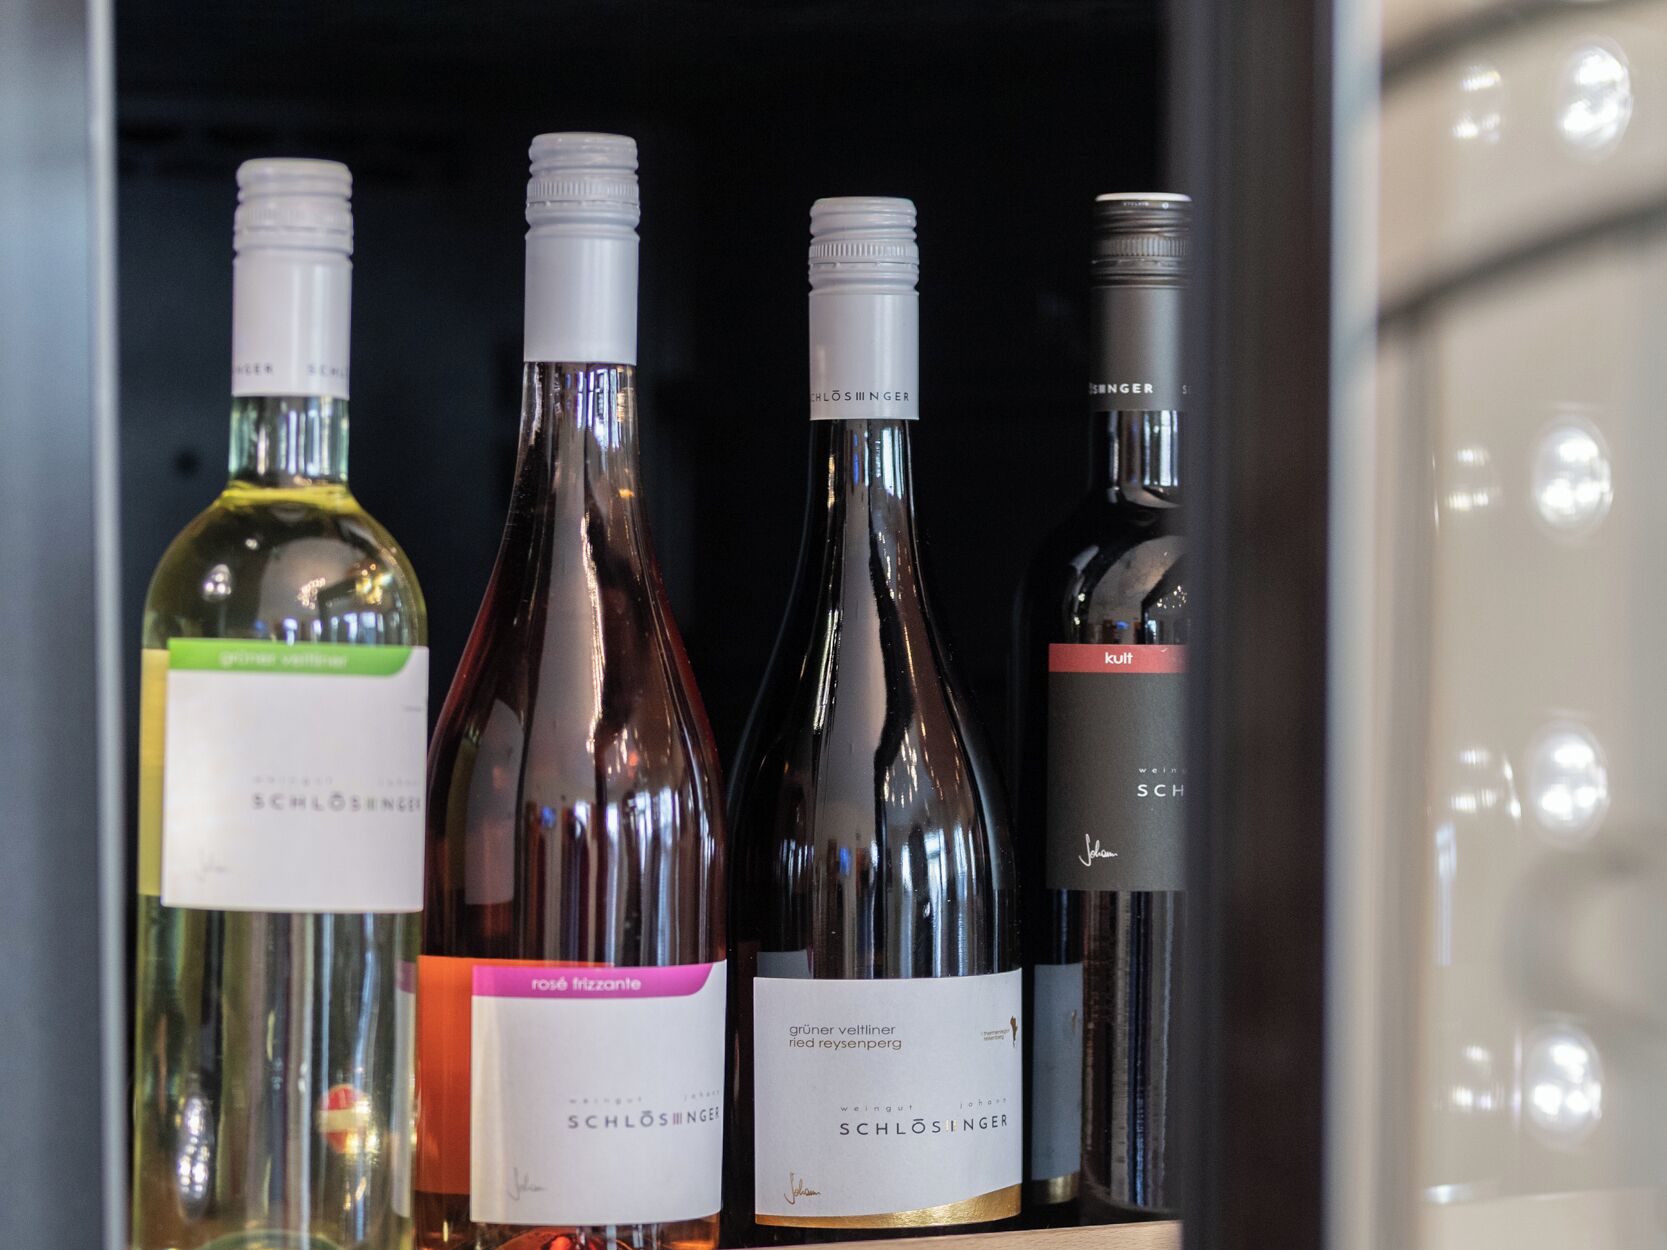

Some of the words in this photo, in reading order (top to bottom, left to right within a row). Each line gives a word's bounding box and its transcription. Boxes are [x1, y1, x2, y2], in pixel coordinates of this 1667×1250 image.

[1104, 652, 1133, 665] kult
[532, 976, 568, 991] rosé
[572, 977, 642, 991] frizzante
[789, 1023, 834, 1036] grüner
[838, 1023, 896, 1036] veltliner
[789, 1036, 815, 1048] ried
[818, 1038, 902, 1050] reysenperg
[840, 1103, 913, 1113] weingut
